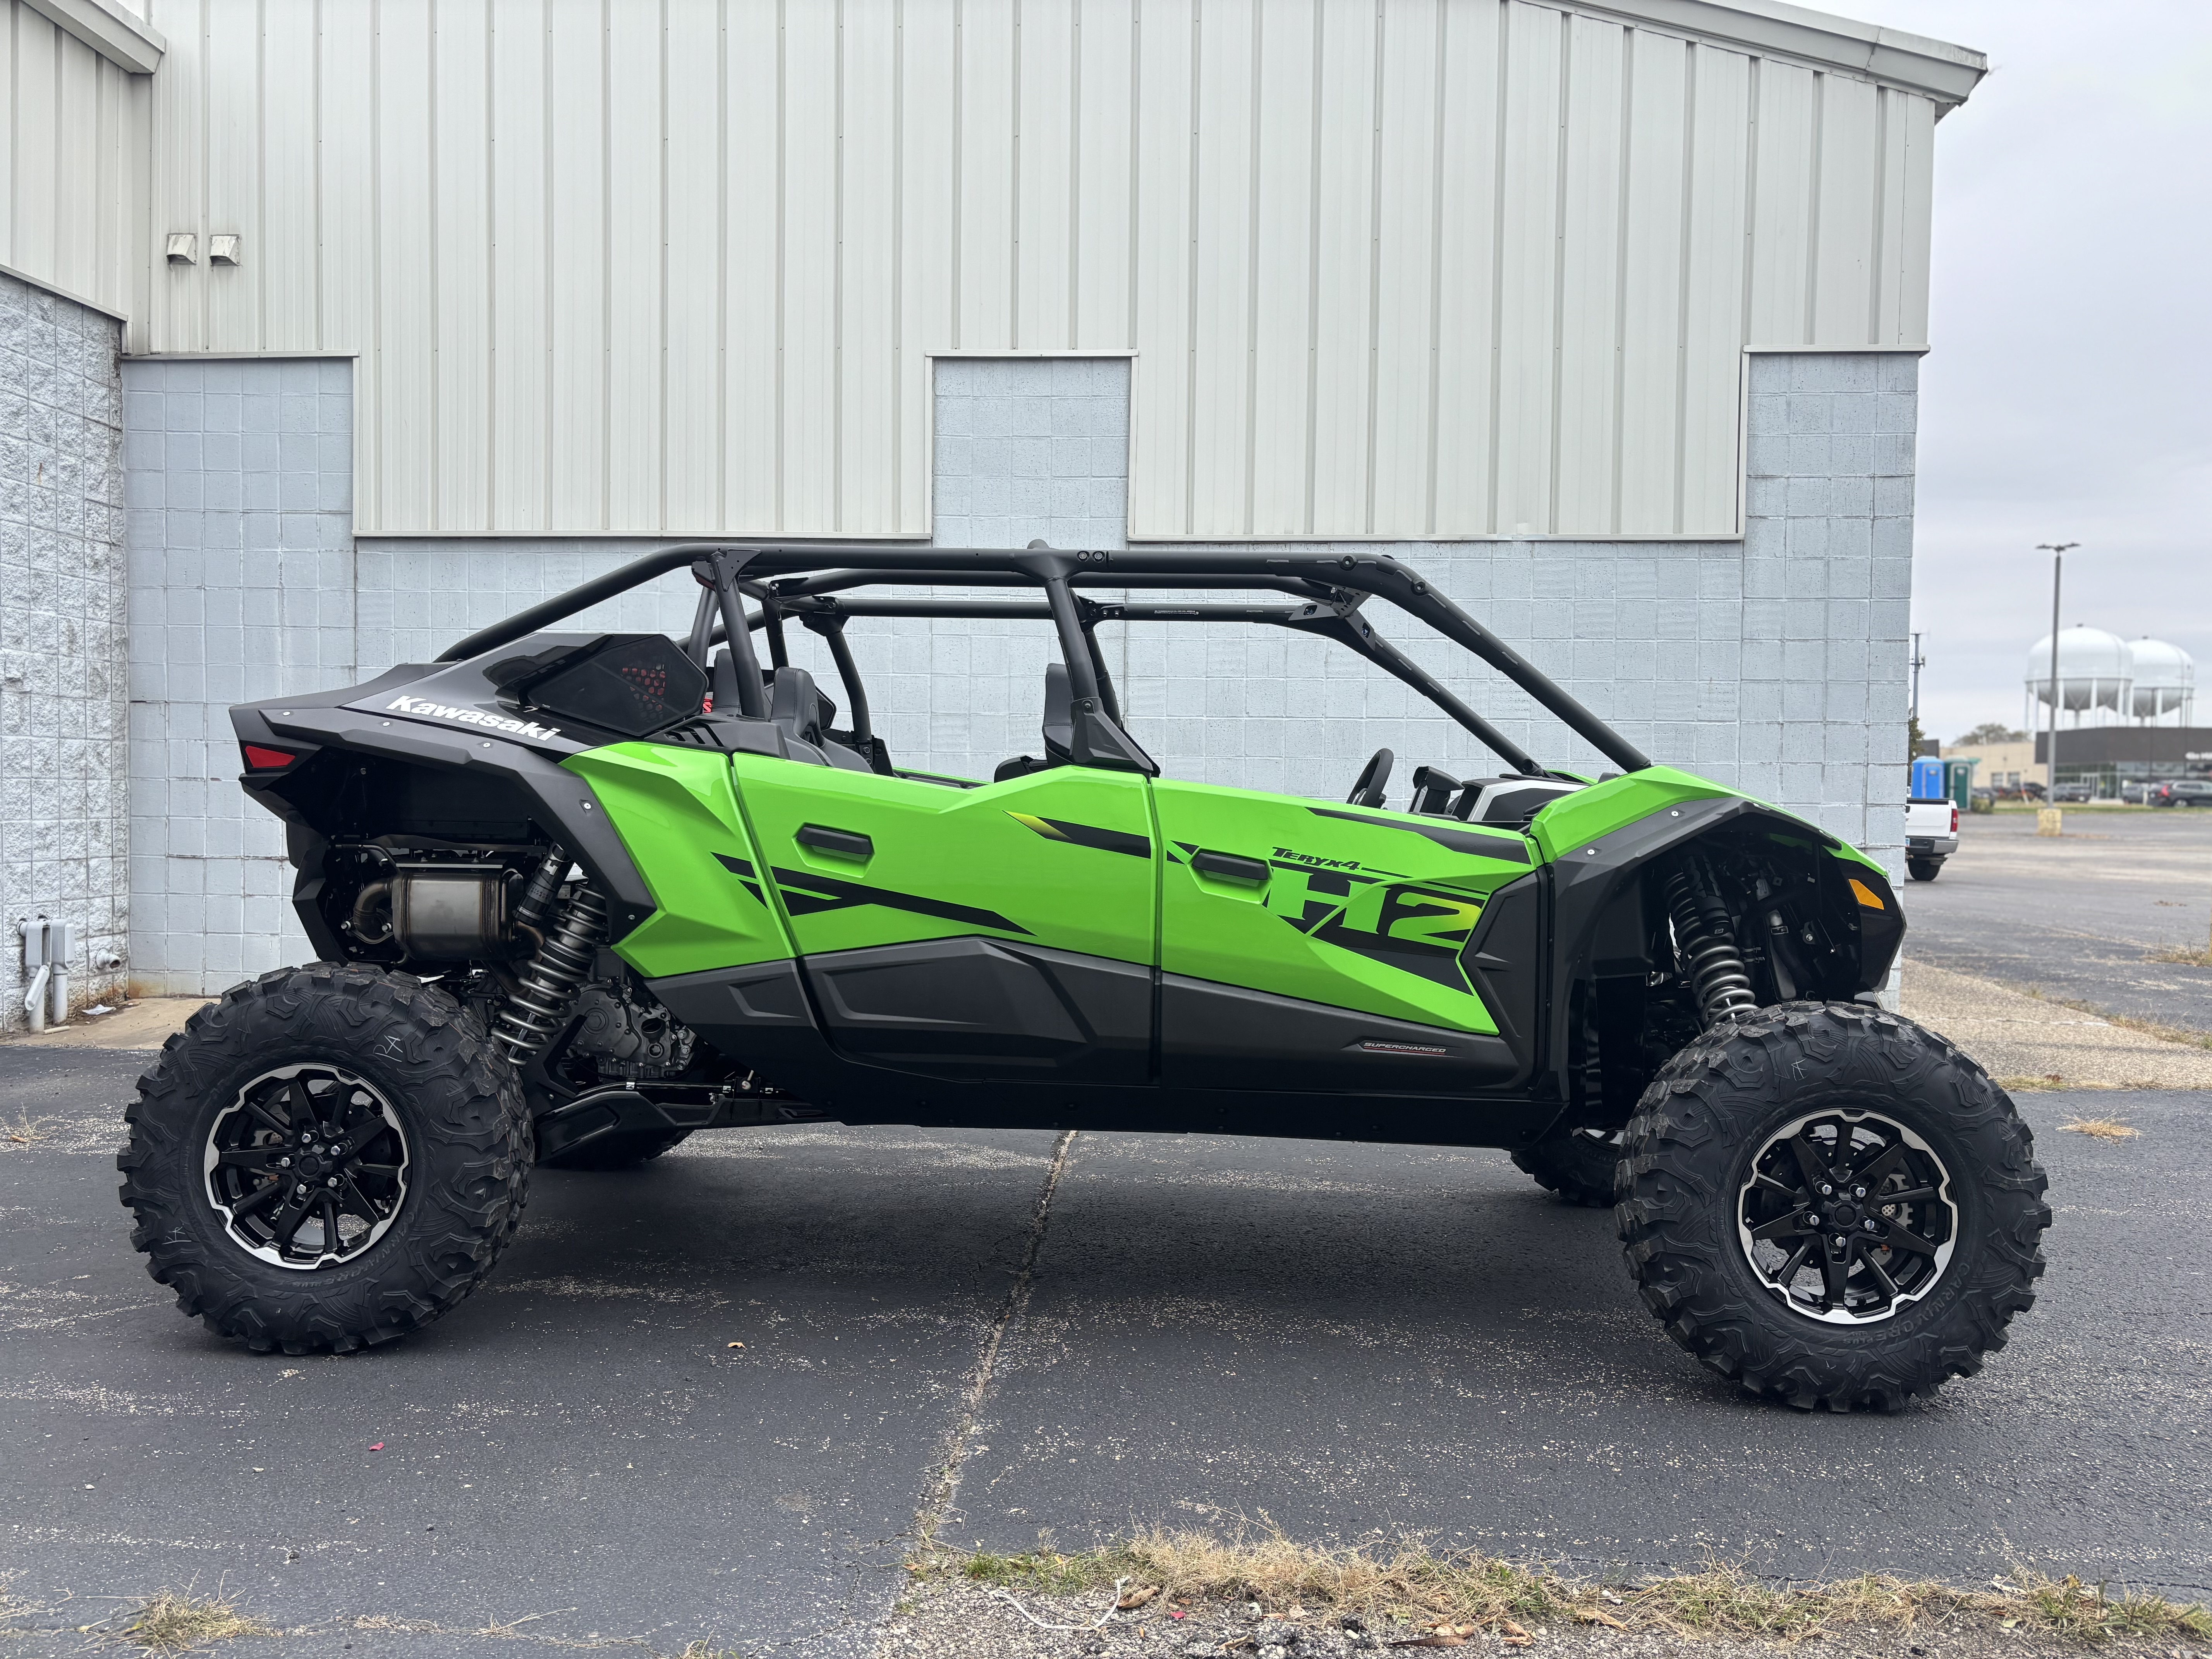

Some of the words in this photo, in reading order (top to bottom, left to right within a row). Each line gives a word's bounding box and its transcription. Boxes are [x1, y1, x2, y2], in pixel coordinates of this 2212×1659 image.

[386, 696, 561, 741] Kawasaki
[1267, 867, 1481, 950] H2
[1364, 1042, 1446, 1053] SUPERCHARGED
